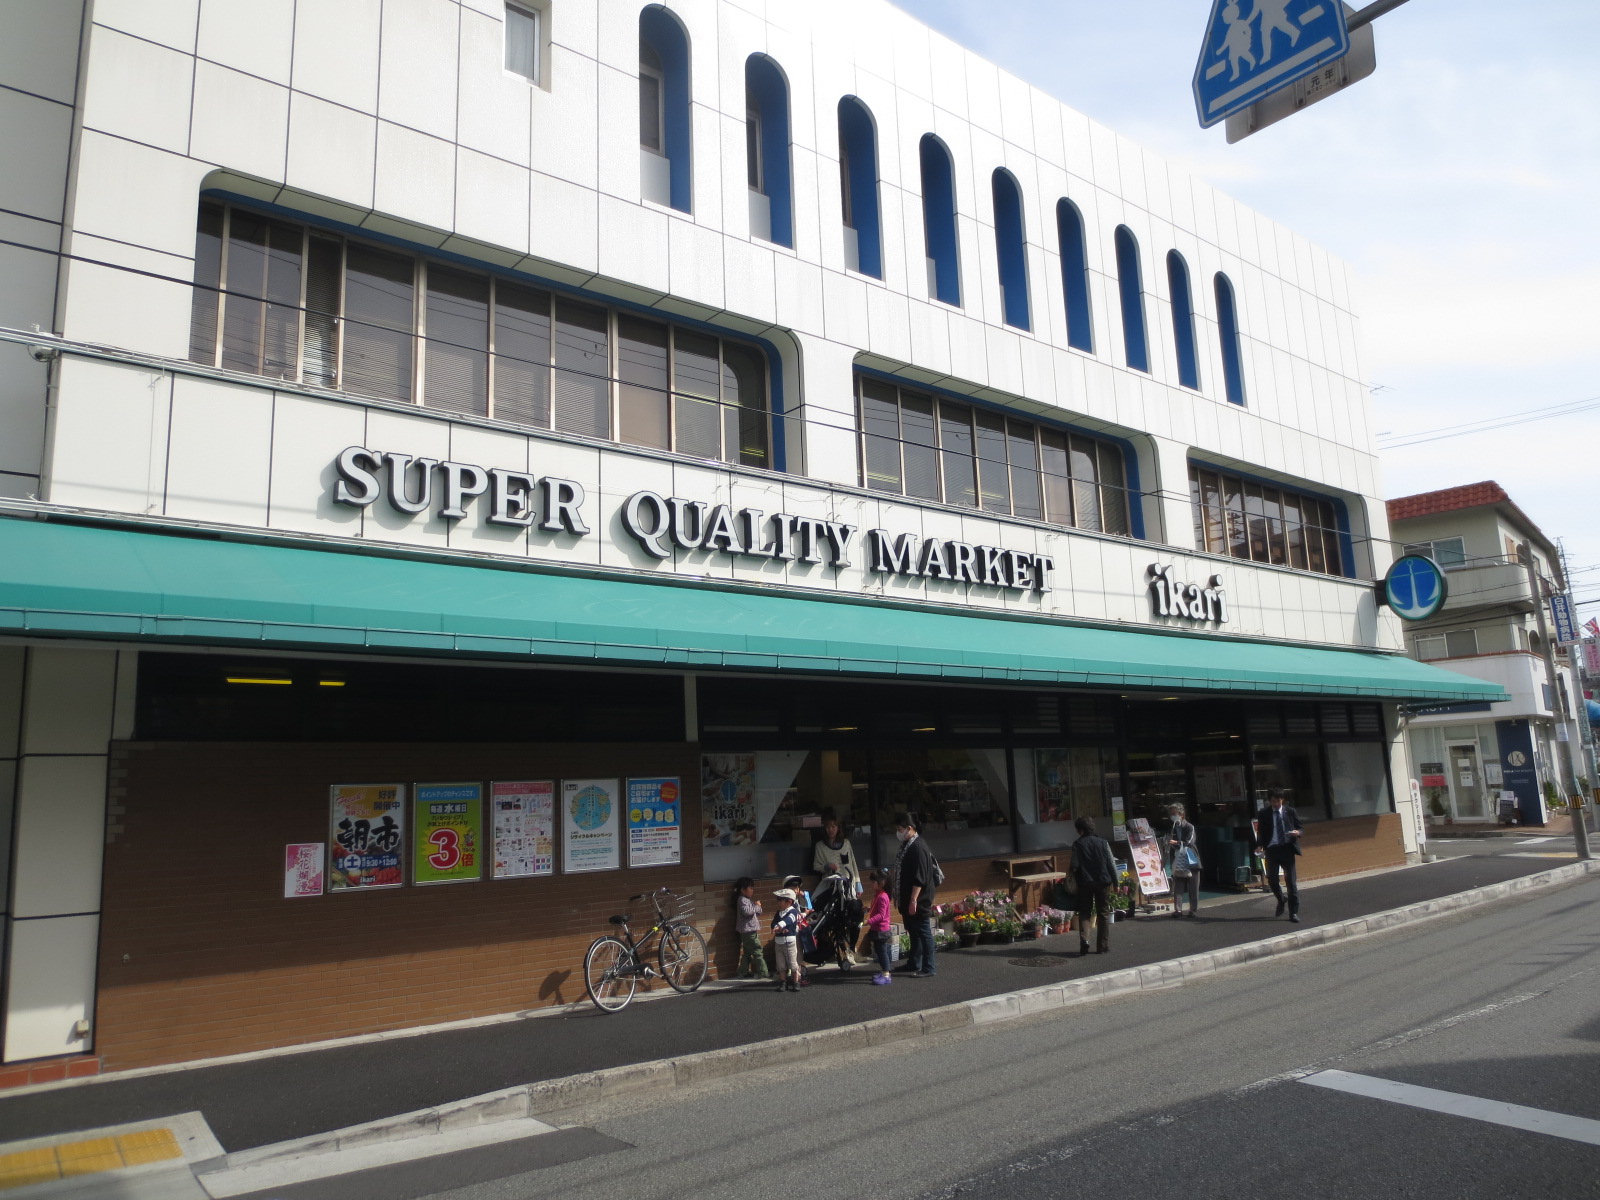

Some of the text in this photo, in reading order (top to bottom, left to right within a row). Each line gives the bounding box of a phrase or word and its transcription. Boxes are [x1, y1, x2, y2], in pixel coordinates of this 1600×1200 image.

[333, 446, 1229, 623] SUPER QUALITY MARKET ikari
[379, 789, 396, 800] 好評
[630, 796, 661, 804] お届けします
[374, 801, 400, 810] 開催中
[430, 803, 467, 814] 毎週水曜日
[714, 805, 747, 820] ikari
[337, 816, 400, 852] 朝市
[570, 832, 613, 840] リサイクルキャンペーン
[428, 828, 474, 870] 3 倍
[366, 859, 378, 867] 9:30
[383, 858, 397, 866] 12:00
[298, 848, 311, 891] 桜花爛漫
[360, 875, 376, 883] ikari
